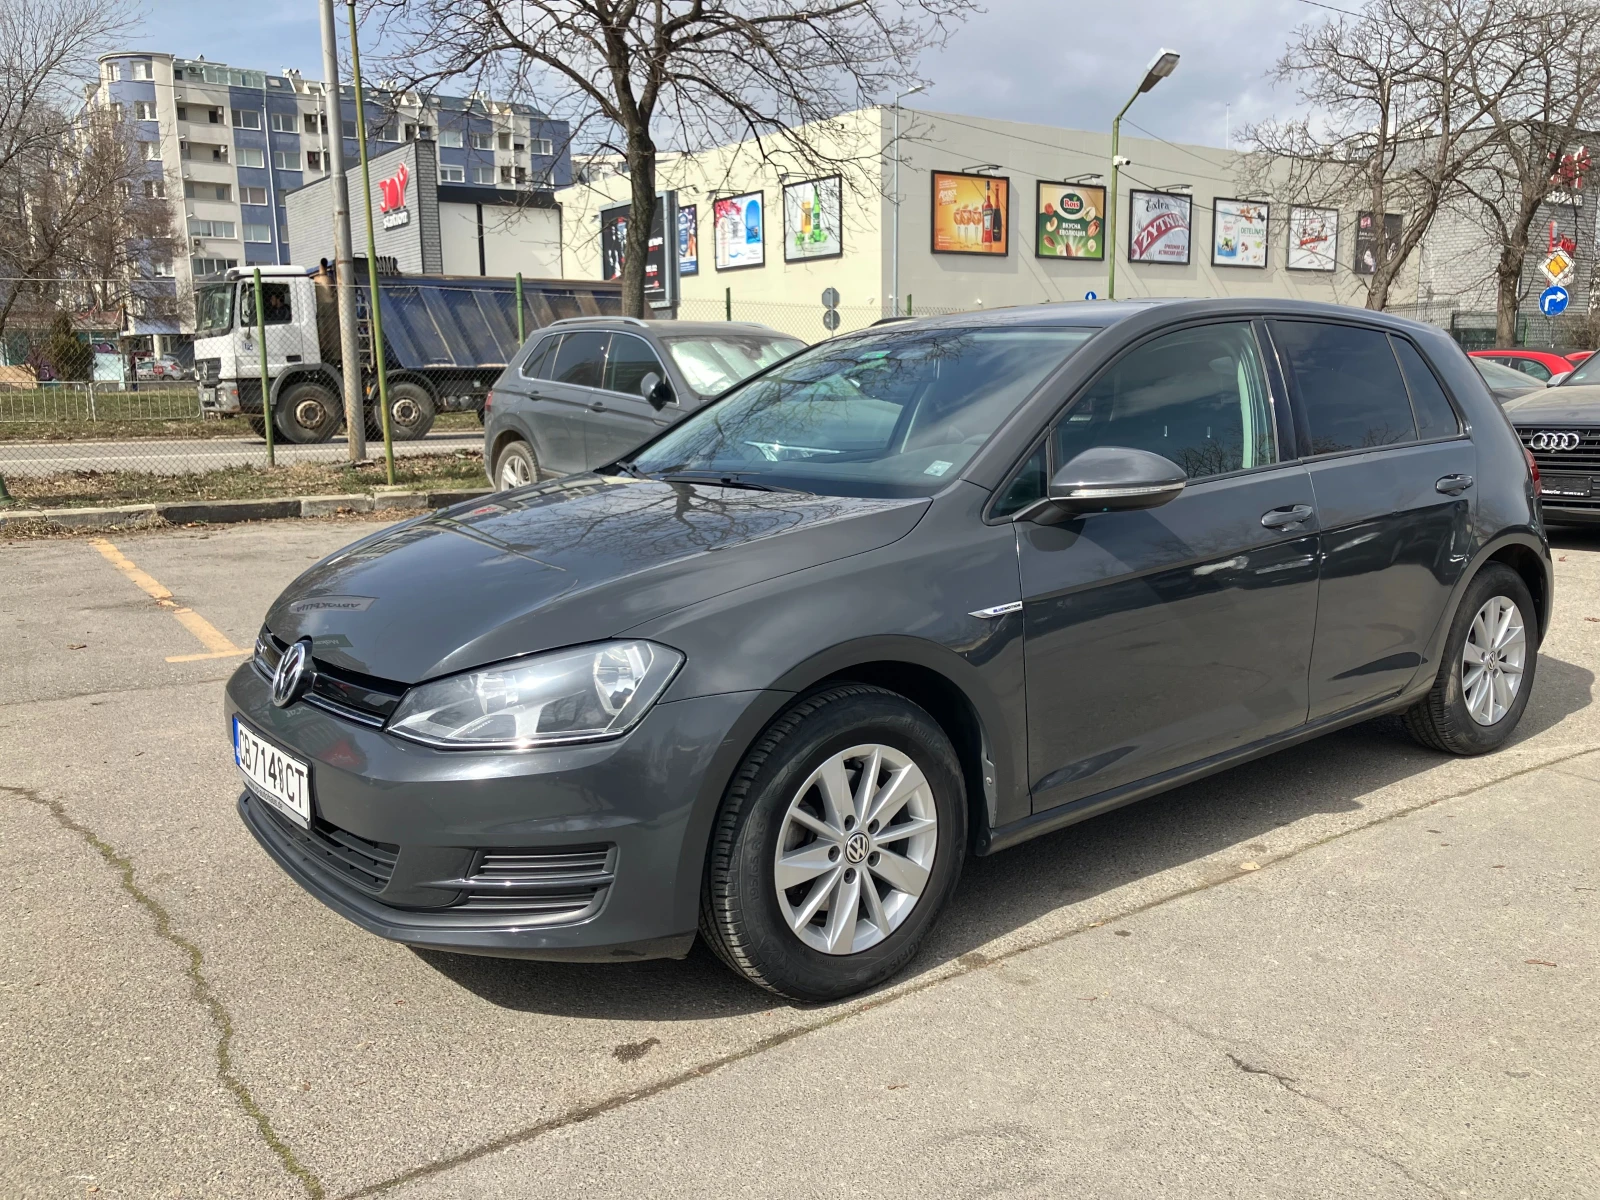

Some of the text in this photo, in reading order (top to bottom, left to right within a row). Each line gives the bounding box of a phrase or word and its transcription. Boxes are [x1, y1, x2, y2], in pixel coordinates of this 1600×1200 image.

[379, 162, 409, 213] JOY
[1145, 198, 1170, 212] Extra
[383, 211, 408, 228] station
